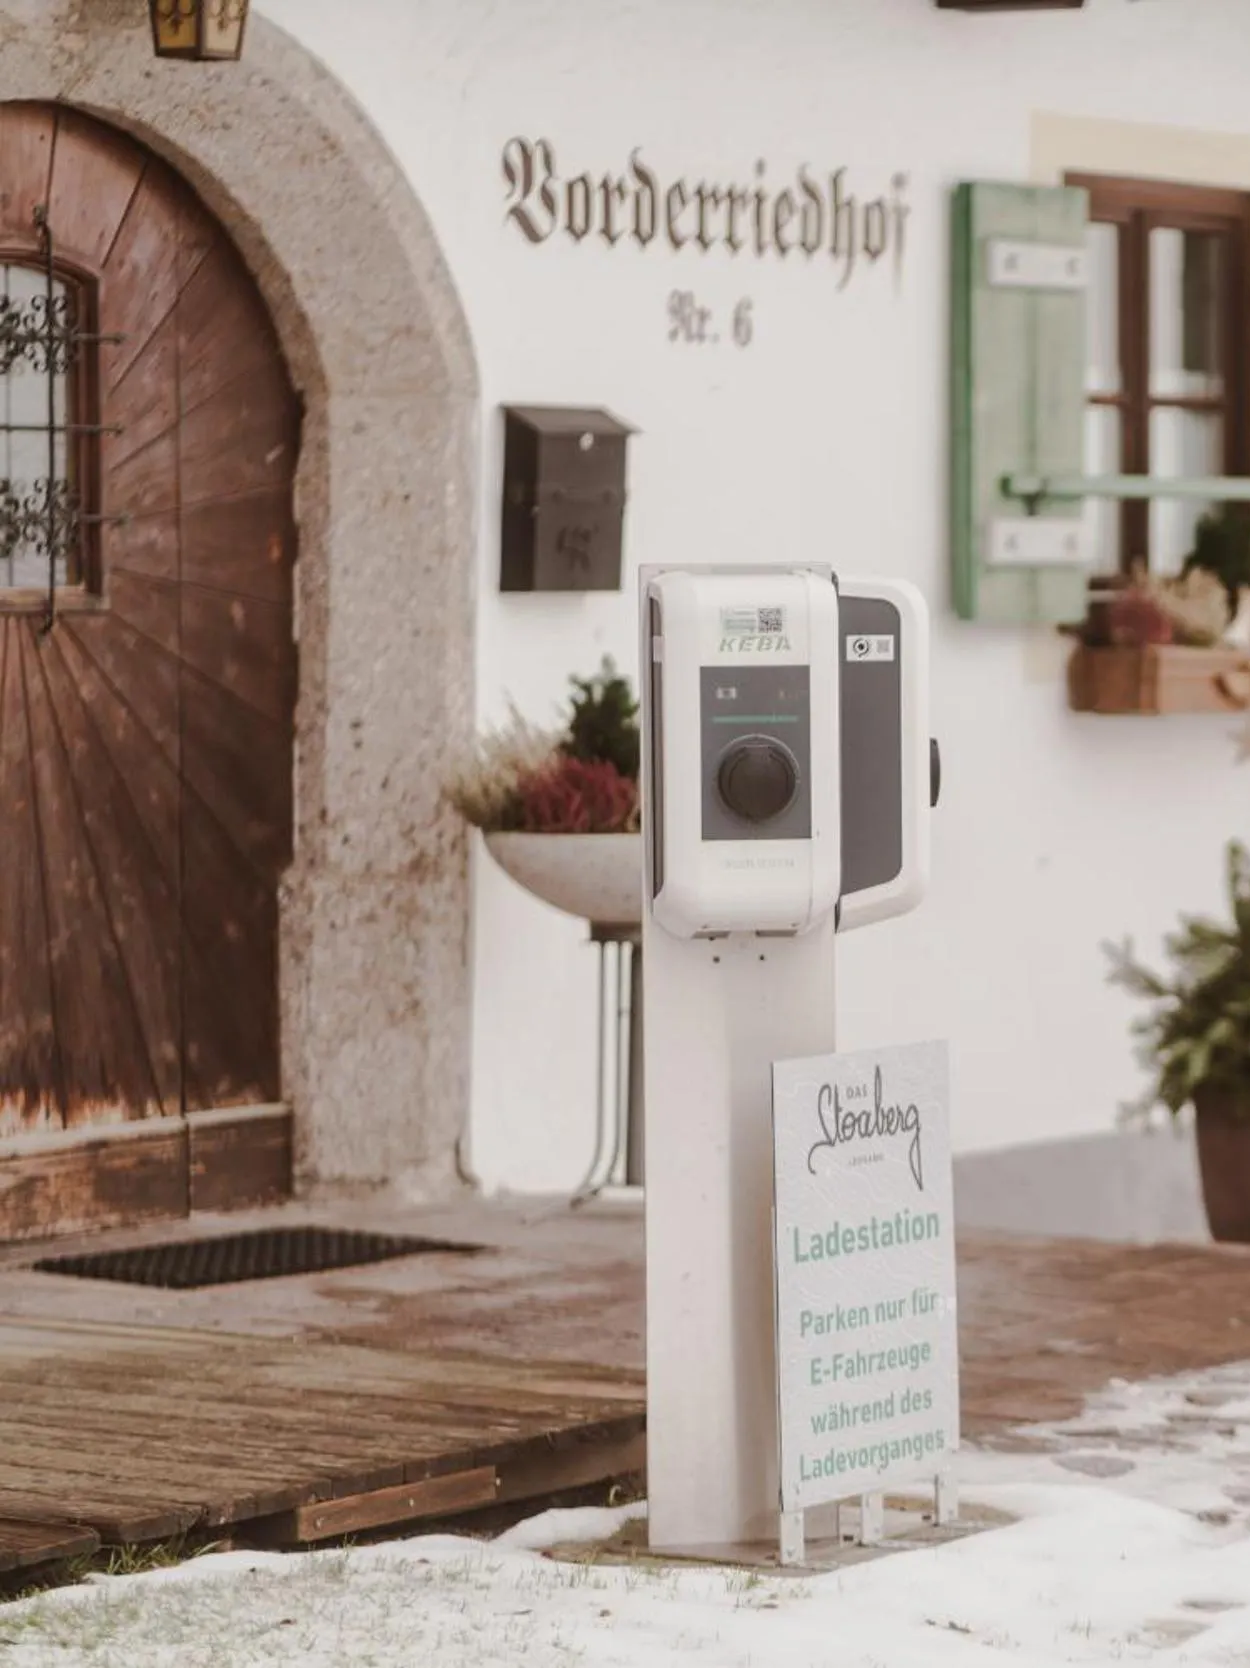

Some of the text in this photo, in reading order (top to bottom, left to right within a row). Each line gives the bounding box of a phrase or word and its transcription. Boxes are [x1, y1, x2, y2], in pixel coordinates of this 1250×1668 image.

[667, 289, 753, 347] Nr. 6
[719, 636, 792, 653] KEBA
[846, 1084, 868, 1100] DAS
[807, 1064, 924, 1191] Stoaberg
[793, 1208, 940, 1264] Ladestation
[800, 1287, 939, 1338] Parken nur für
[810, 1341, 931, 1386] E-Fahrzeuge
[811, 1386, 932, 1435] während des
[800, 1429, 945, 1482] Ladevorganges
